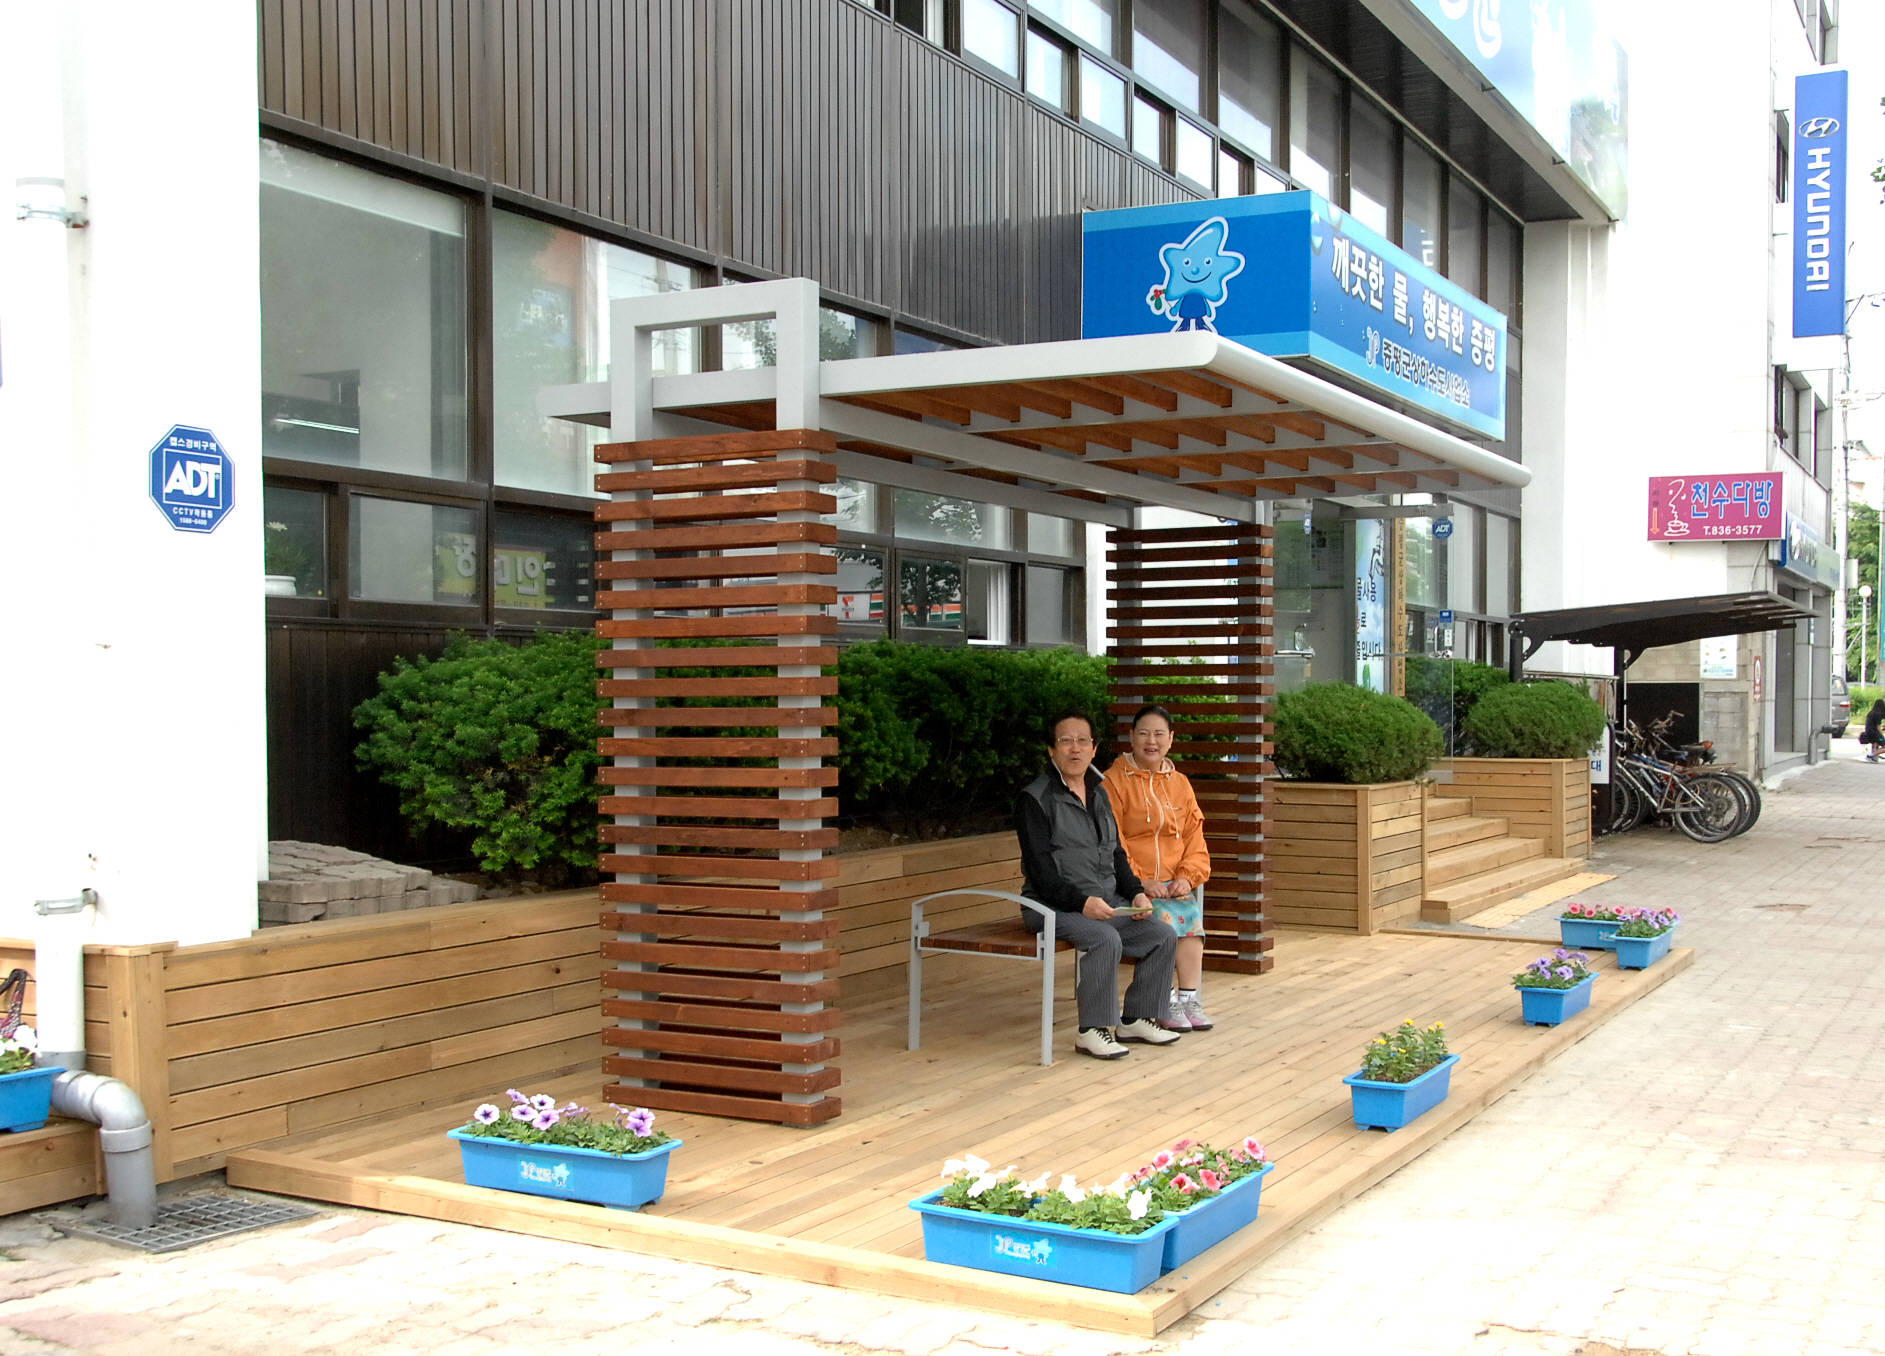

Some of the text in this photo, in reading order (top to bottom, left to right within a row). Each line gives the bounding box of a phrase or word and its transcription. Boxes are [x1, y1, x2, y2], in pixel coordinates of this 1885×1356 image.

[1805, 147, 1831, 291] HYUNDAI
[1332, 237, 1384, 312] 깨끗한
[1422, 289, 1464, 356] 행복한
[1470, 318, 1497, 372] 증평
[1382, 338, 1470, 408] 증평군상하수도사업소
[165, 460, 221, 498] ADT
[1691, 480, 1773, 519] 천수다방
[1435, 525, 1450, 533] ADT
[1703, 525, 1762, 536] T.836-3577
